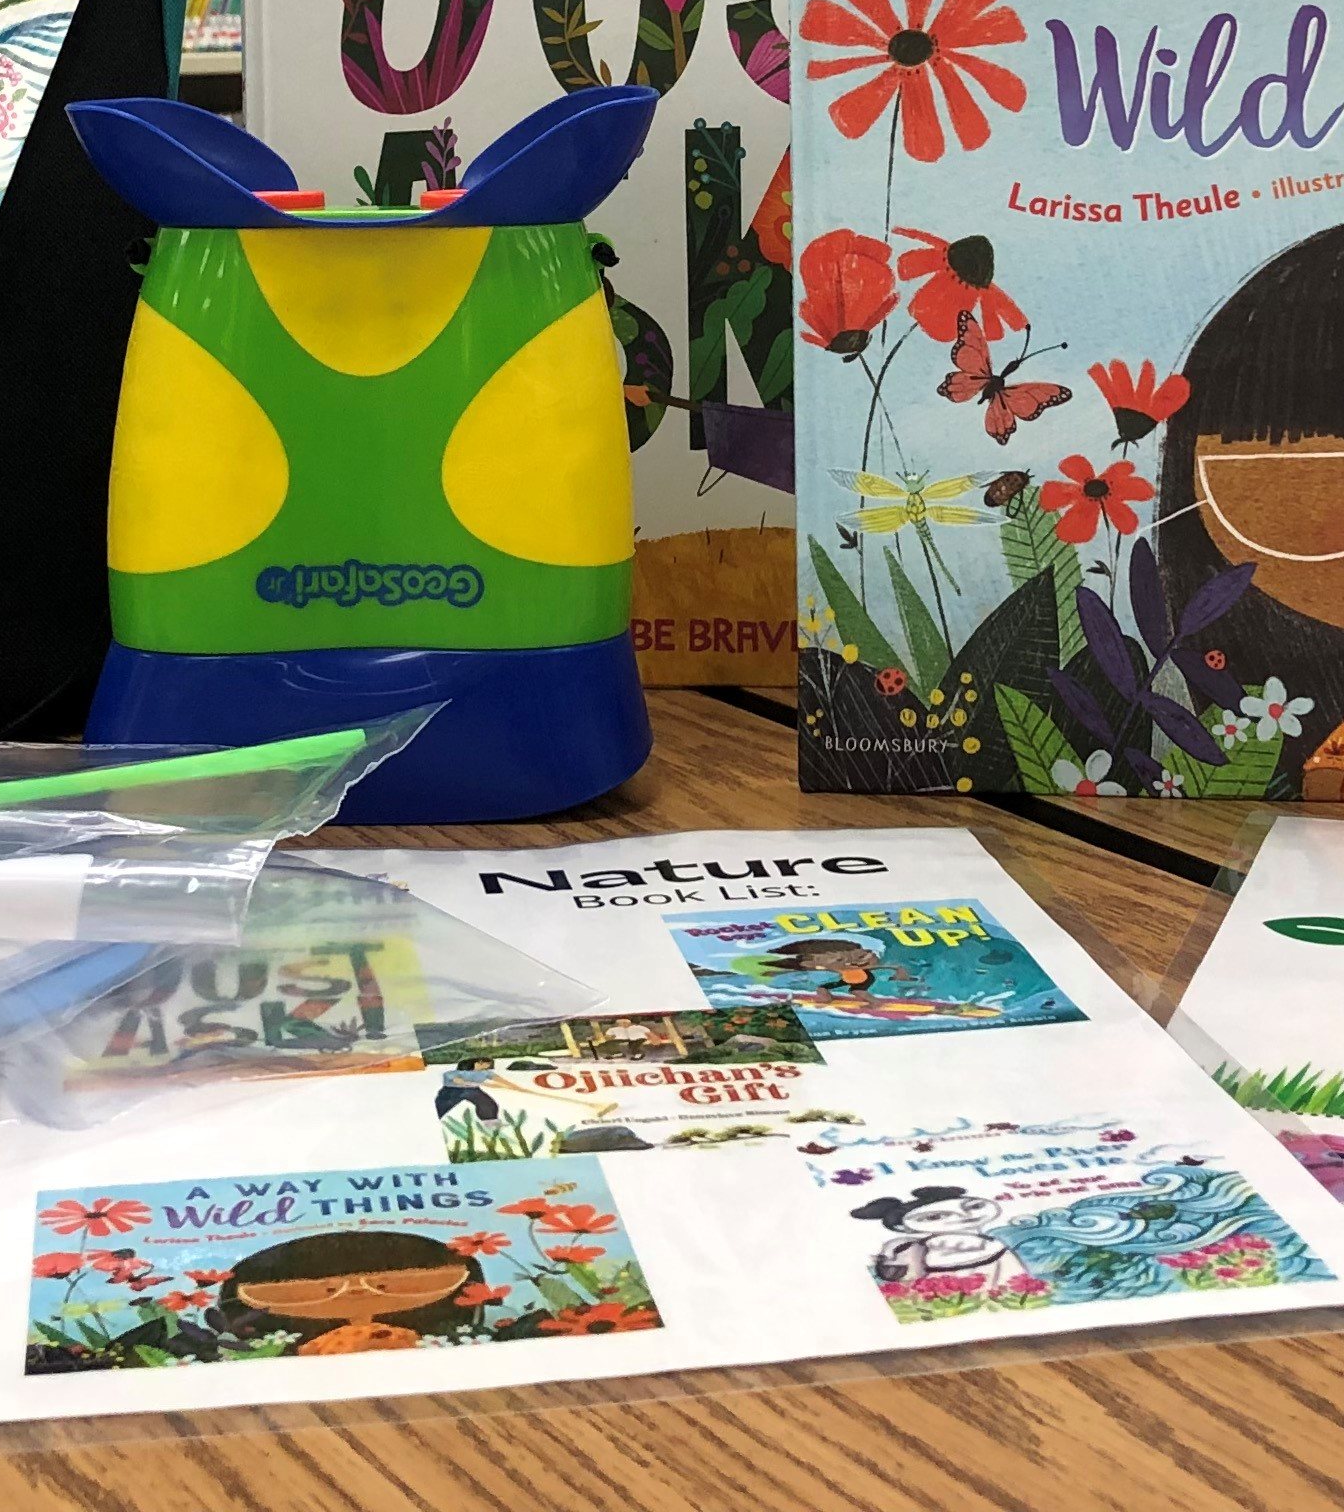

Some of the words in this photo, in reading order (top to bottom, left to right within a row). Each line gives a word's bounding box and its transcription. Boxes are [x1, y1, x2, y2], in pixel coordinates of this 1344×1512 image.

[1007, 180, 1125, 225] Larissa
[1132, 182, 1242, 224] Theule
[824, 735, 949, 754] BLOOMSBURY
[477, 852, 889, 897] Nature
[572, 889, 706, 911] Book
[717, 882, 821, 902] List:
[774, 904, 982, 937] CLEAN
[892, 919, 993, 948] UP!
[533, 1061, 802, 1095] Ojiichan's
[678, 1080, 790, 1107] Gift
[186, 1184, 212, 1200] A
[233, 1179, 324, 1197] WAY
[347, 1171, 461, 1190] WITH
[162, 1197, 308, 1232] Wild
[312, 1189, 494, 1216] THINGS
